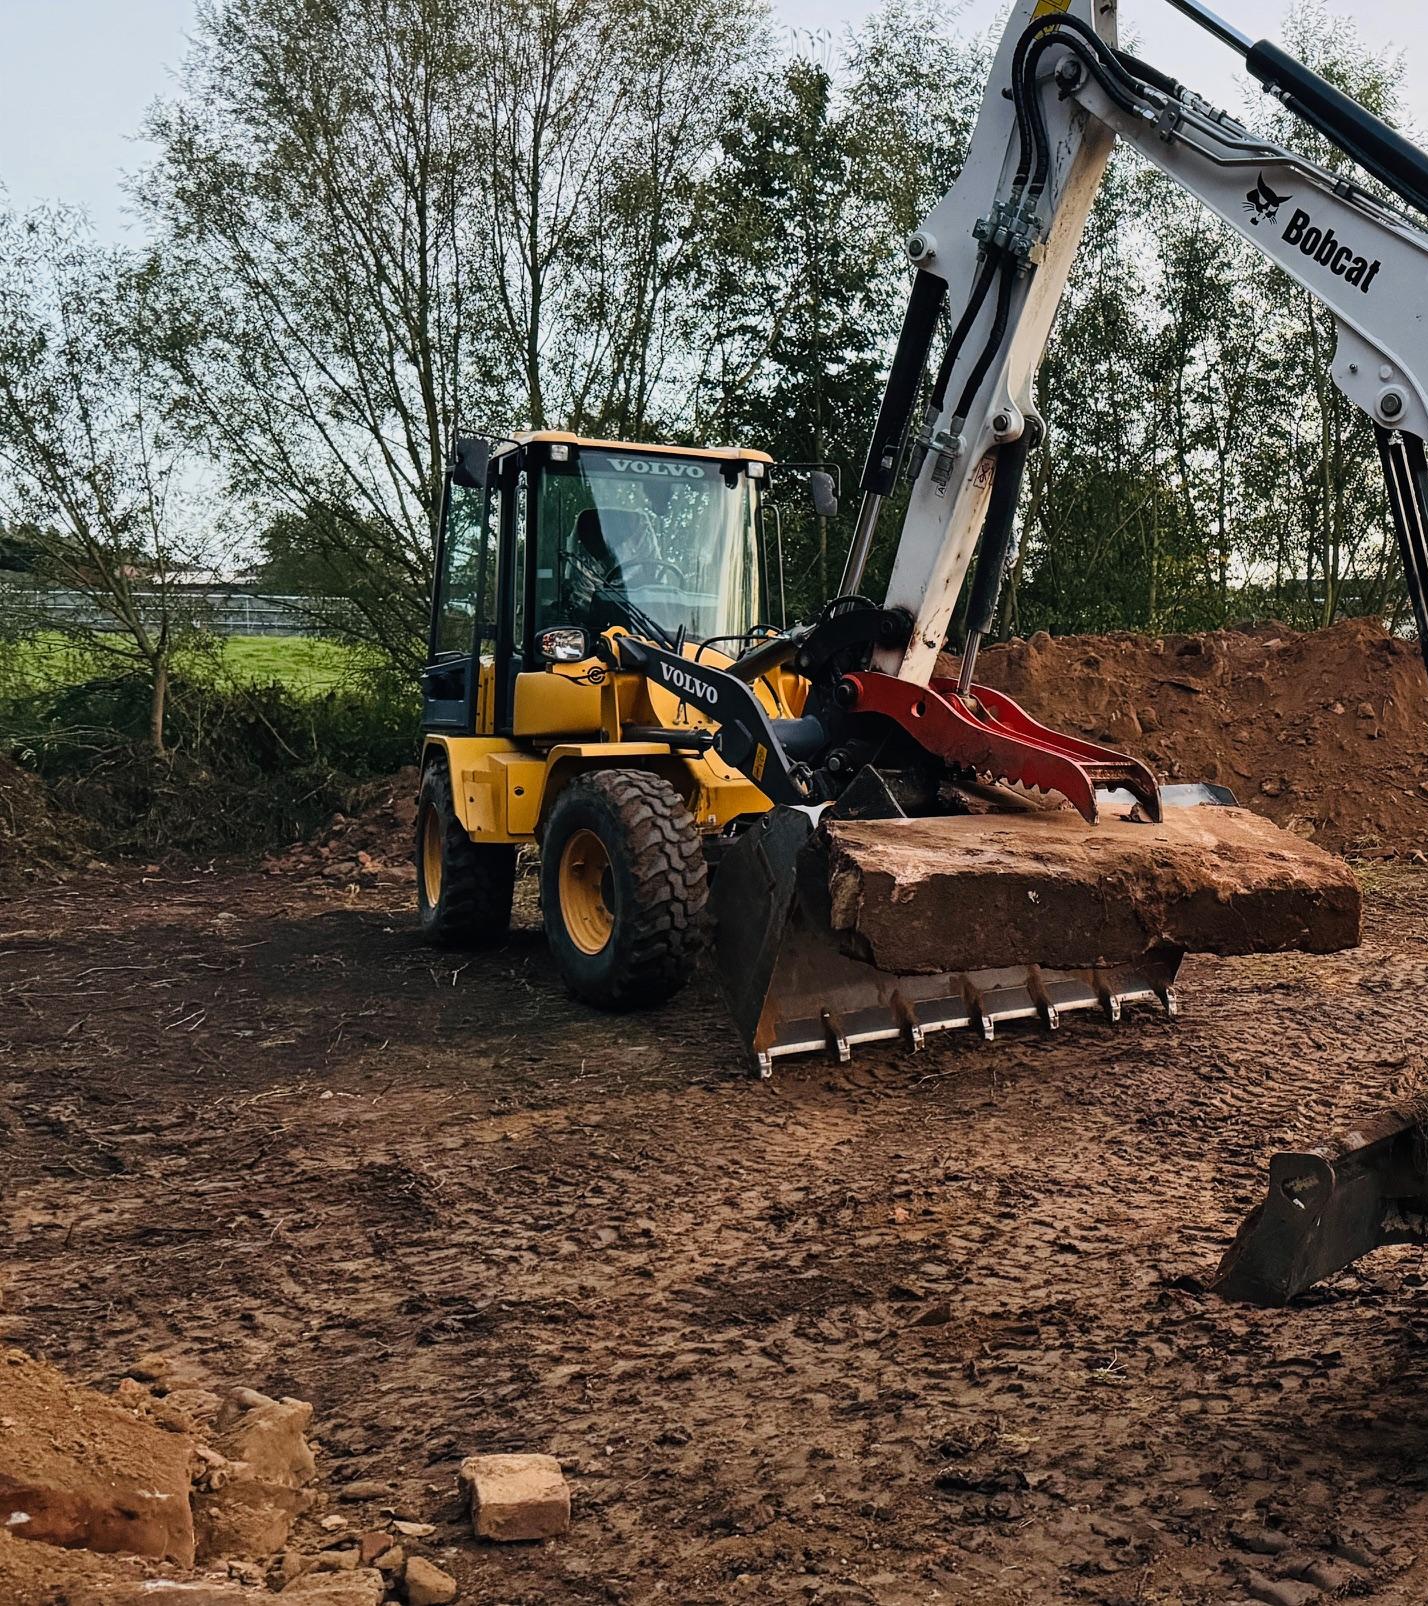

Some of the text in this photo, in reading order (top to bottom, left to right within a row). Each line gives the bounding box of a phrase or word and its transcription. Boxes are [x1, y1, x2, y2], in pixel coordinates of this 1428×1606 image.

[1281, 208, 1381, 294] Bobcat
[607, 458, 705, 479] VOLVO
[660, 661, 718, 704] VOLVO
